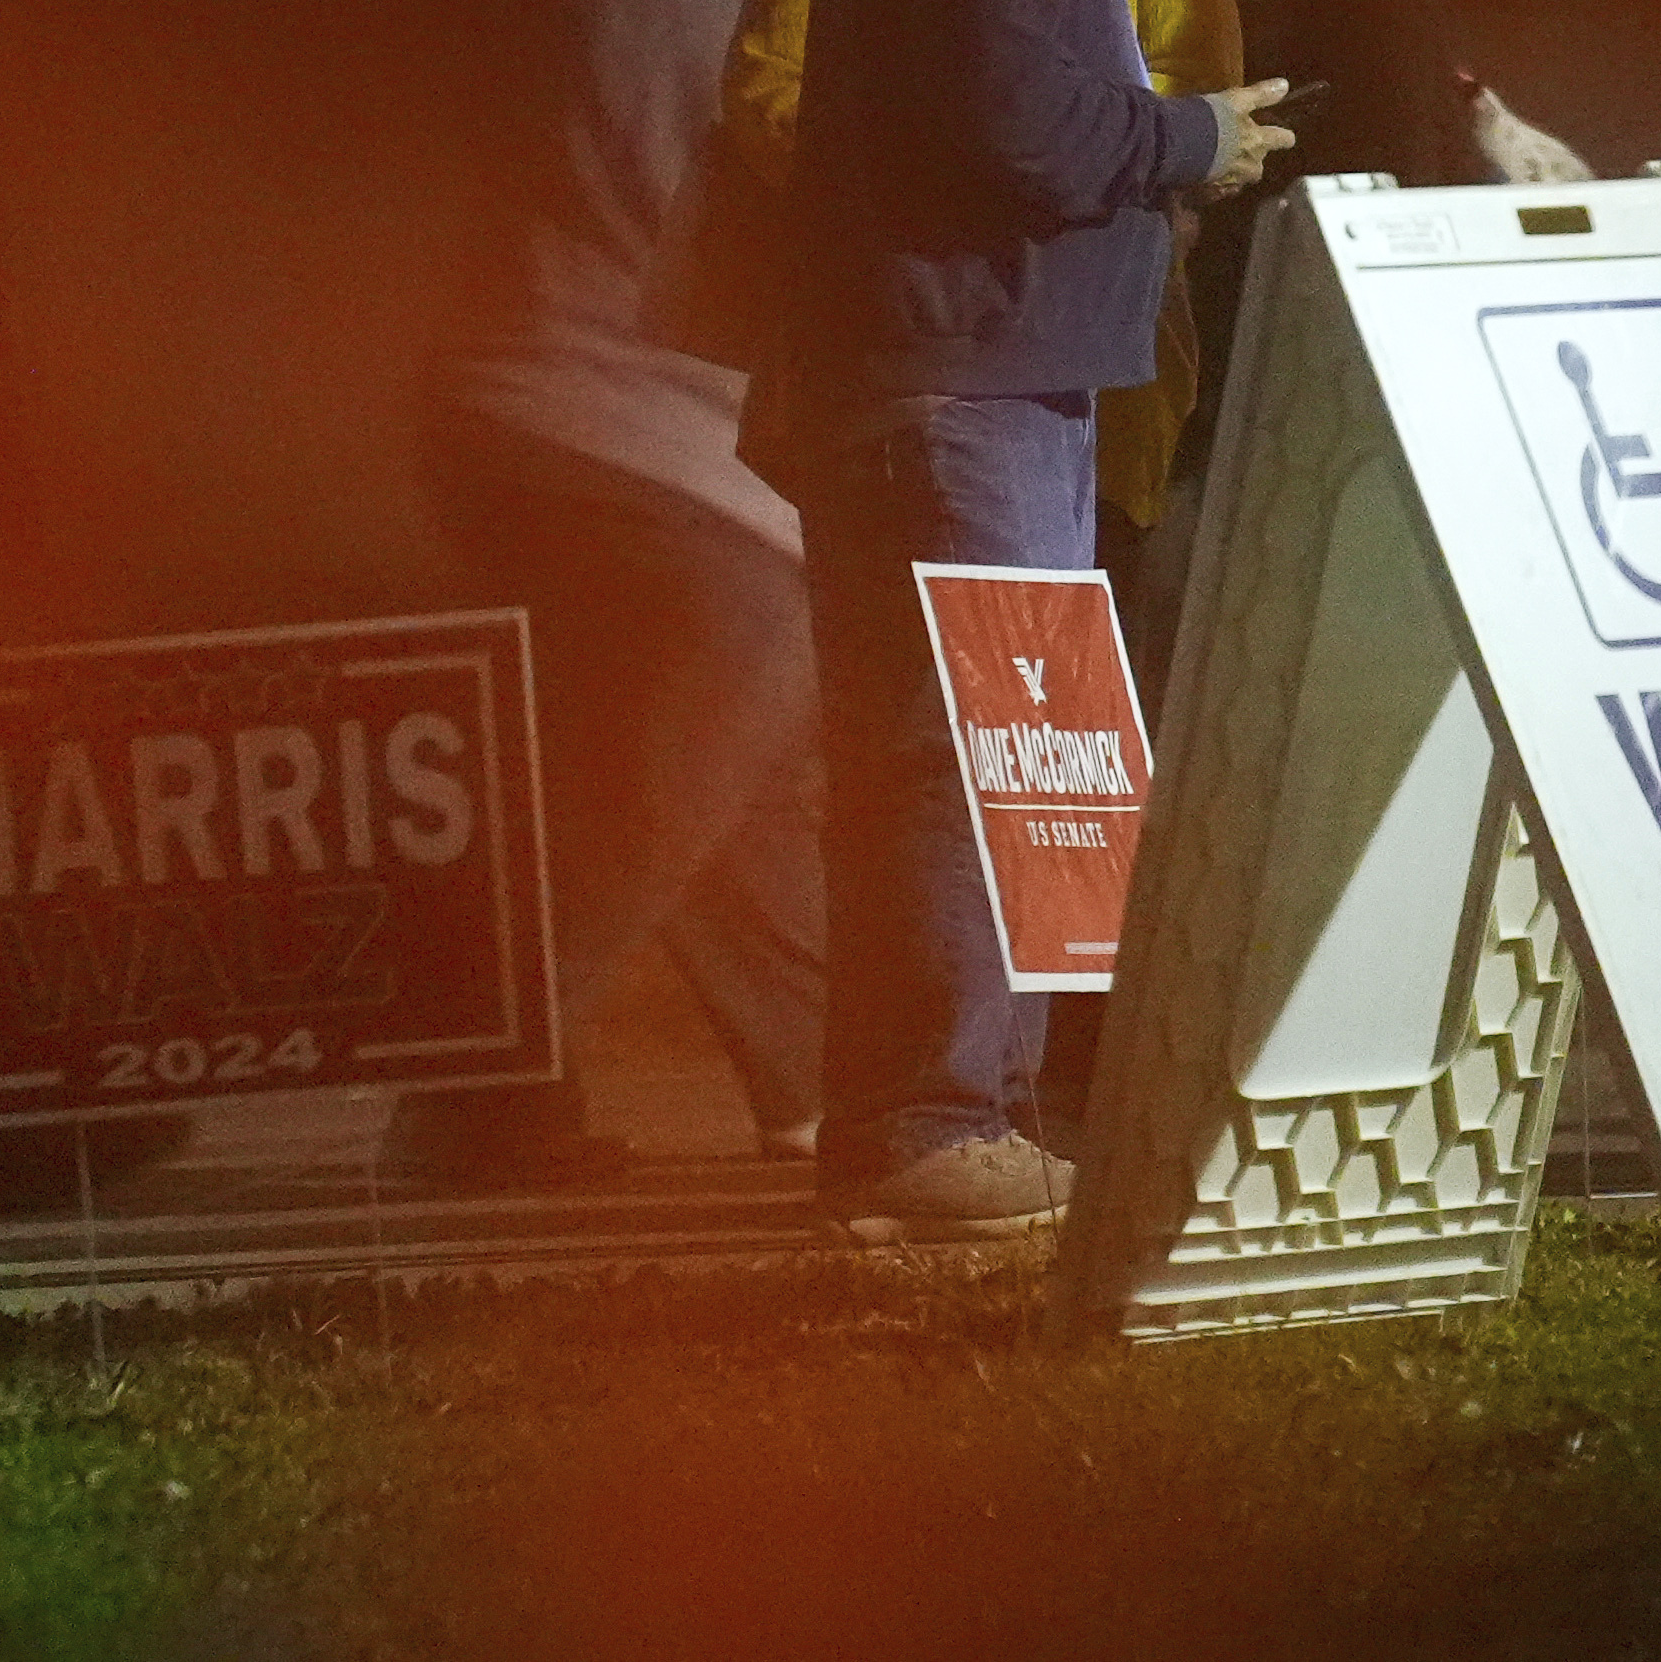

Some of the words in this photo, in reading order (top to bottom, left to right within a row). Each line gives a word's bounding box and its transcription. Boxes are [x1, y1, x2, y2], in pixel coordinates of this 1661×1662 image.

[967, 720, 1021, 791] DAVE
[1052, 822, 1107, 848] SENATE
[97, 1028, 323, 1089] 2024
